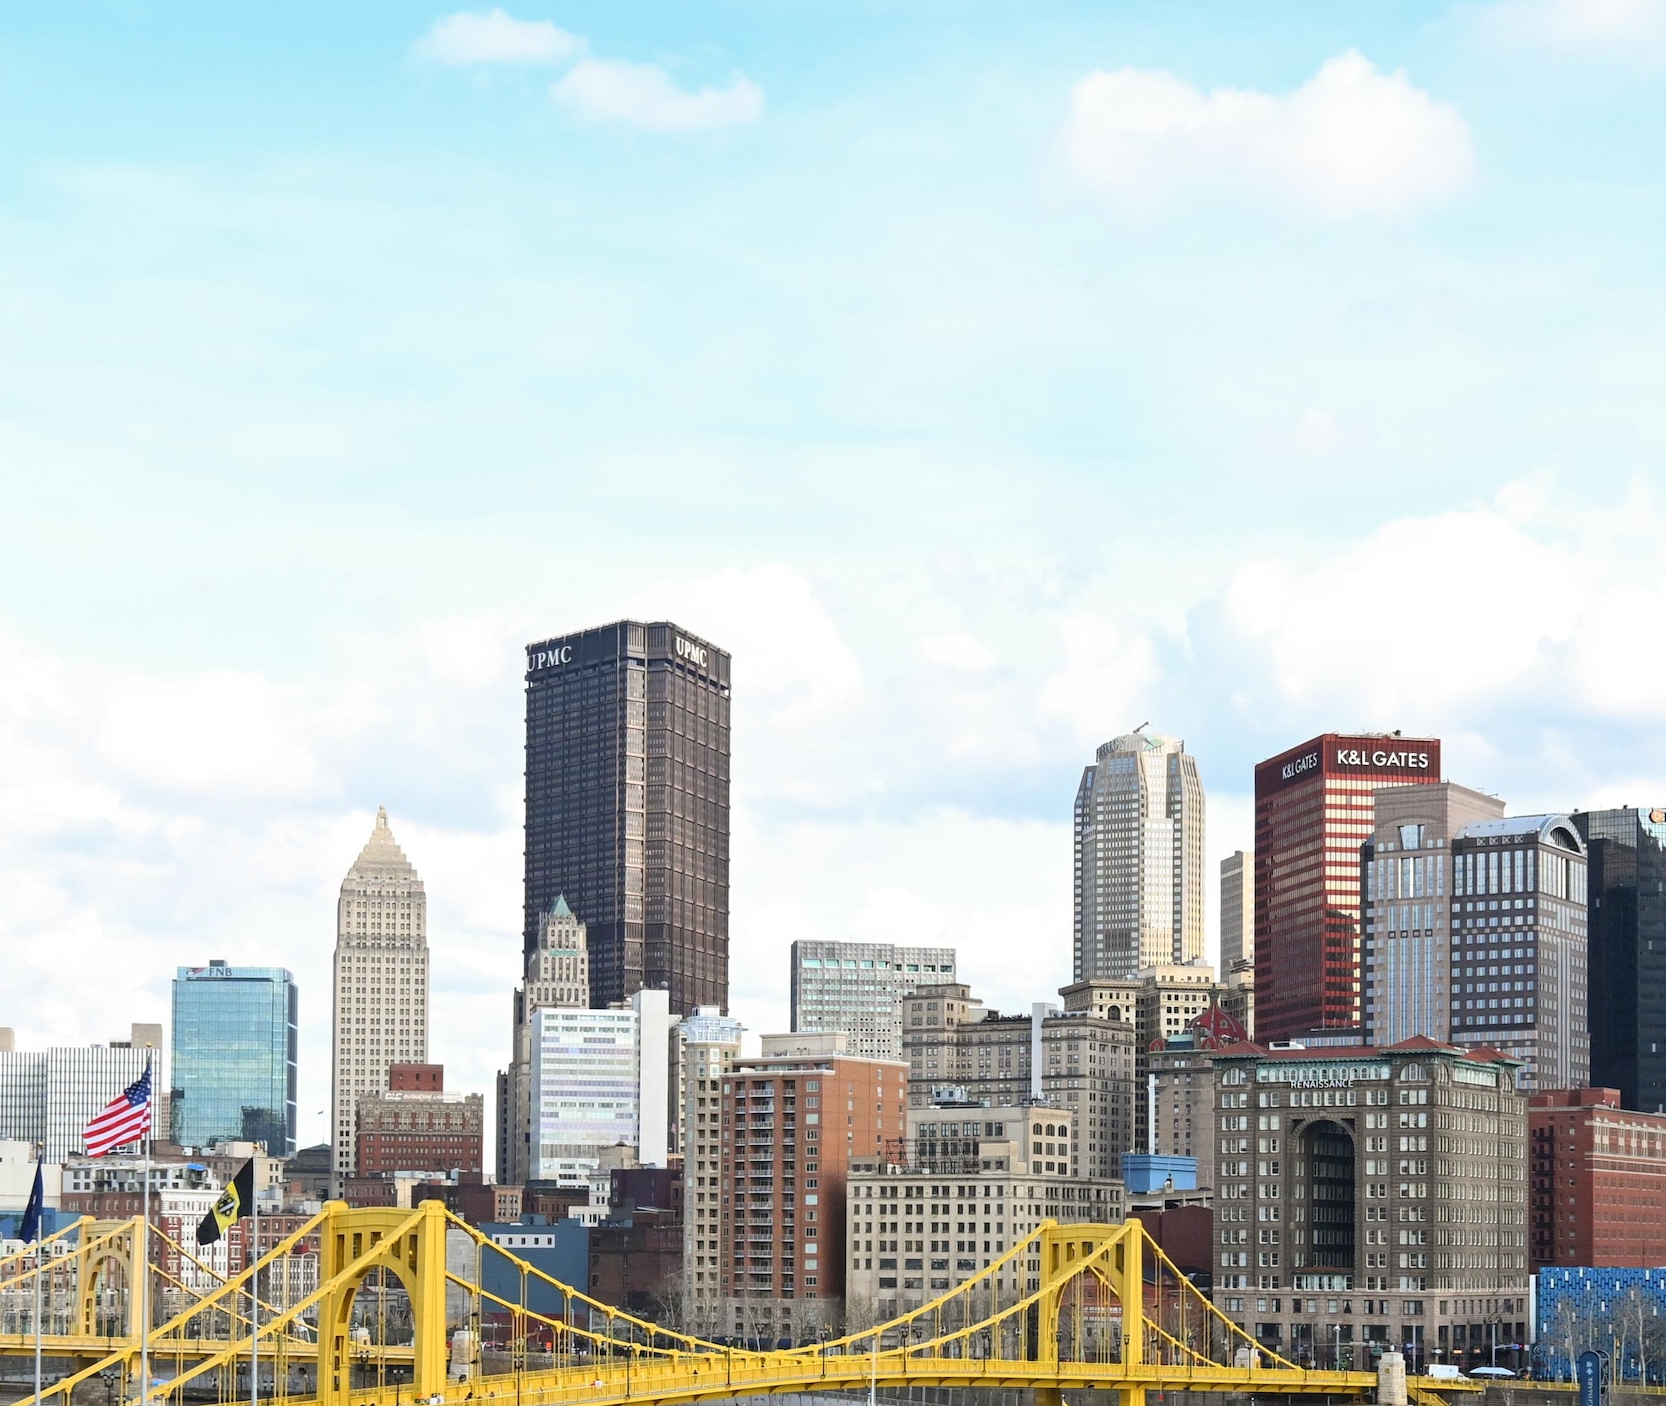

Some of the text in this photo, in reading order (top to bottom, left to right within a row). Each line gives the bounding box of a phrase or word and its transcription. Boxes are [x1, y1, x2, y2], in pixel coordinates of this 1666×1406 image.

[527, 646, 572, 672] UPMC
[675, 636, 707, 667] UPMC
[1282, 752, 1317, 780] K&L GATES
[1337, 750, 1428, 768] K&L GATES
[208, 967, 232, 977] FNB
[1291, 1080, 1353, 1088] RENAISSANCE
